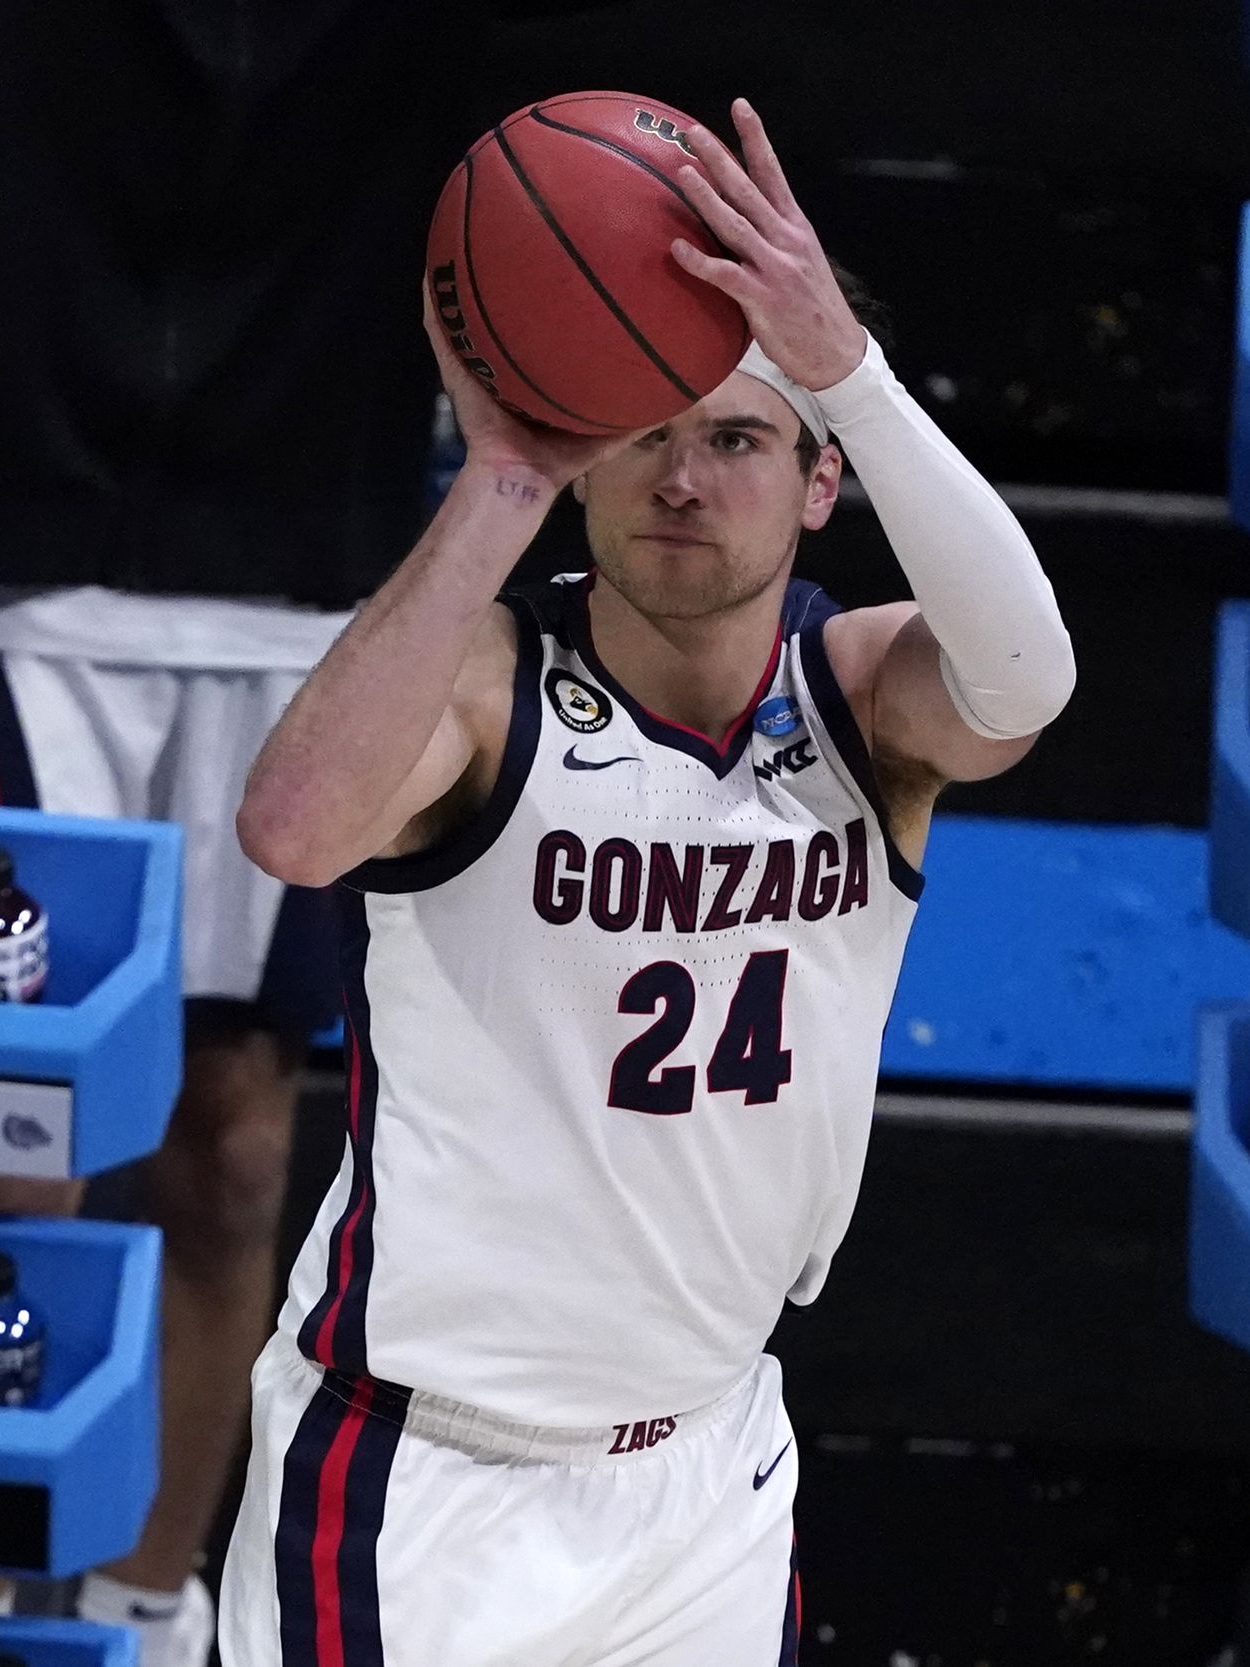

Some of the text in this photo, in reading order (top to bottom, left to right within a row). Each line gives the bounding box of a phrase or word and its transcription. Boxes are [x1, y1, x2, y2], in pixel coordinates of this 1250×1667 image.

[558, 709, 583, 730] United
[753, 736, 818, 782] WCC
[532, 818, 869, 934] GONZAGA
[607, 949, 792, 1115] 24
[607, 1415, 677, 1455] ZAGS
